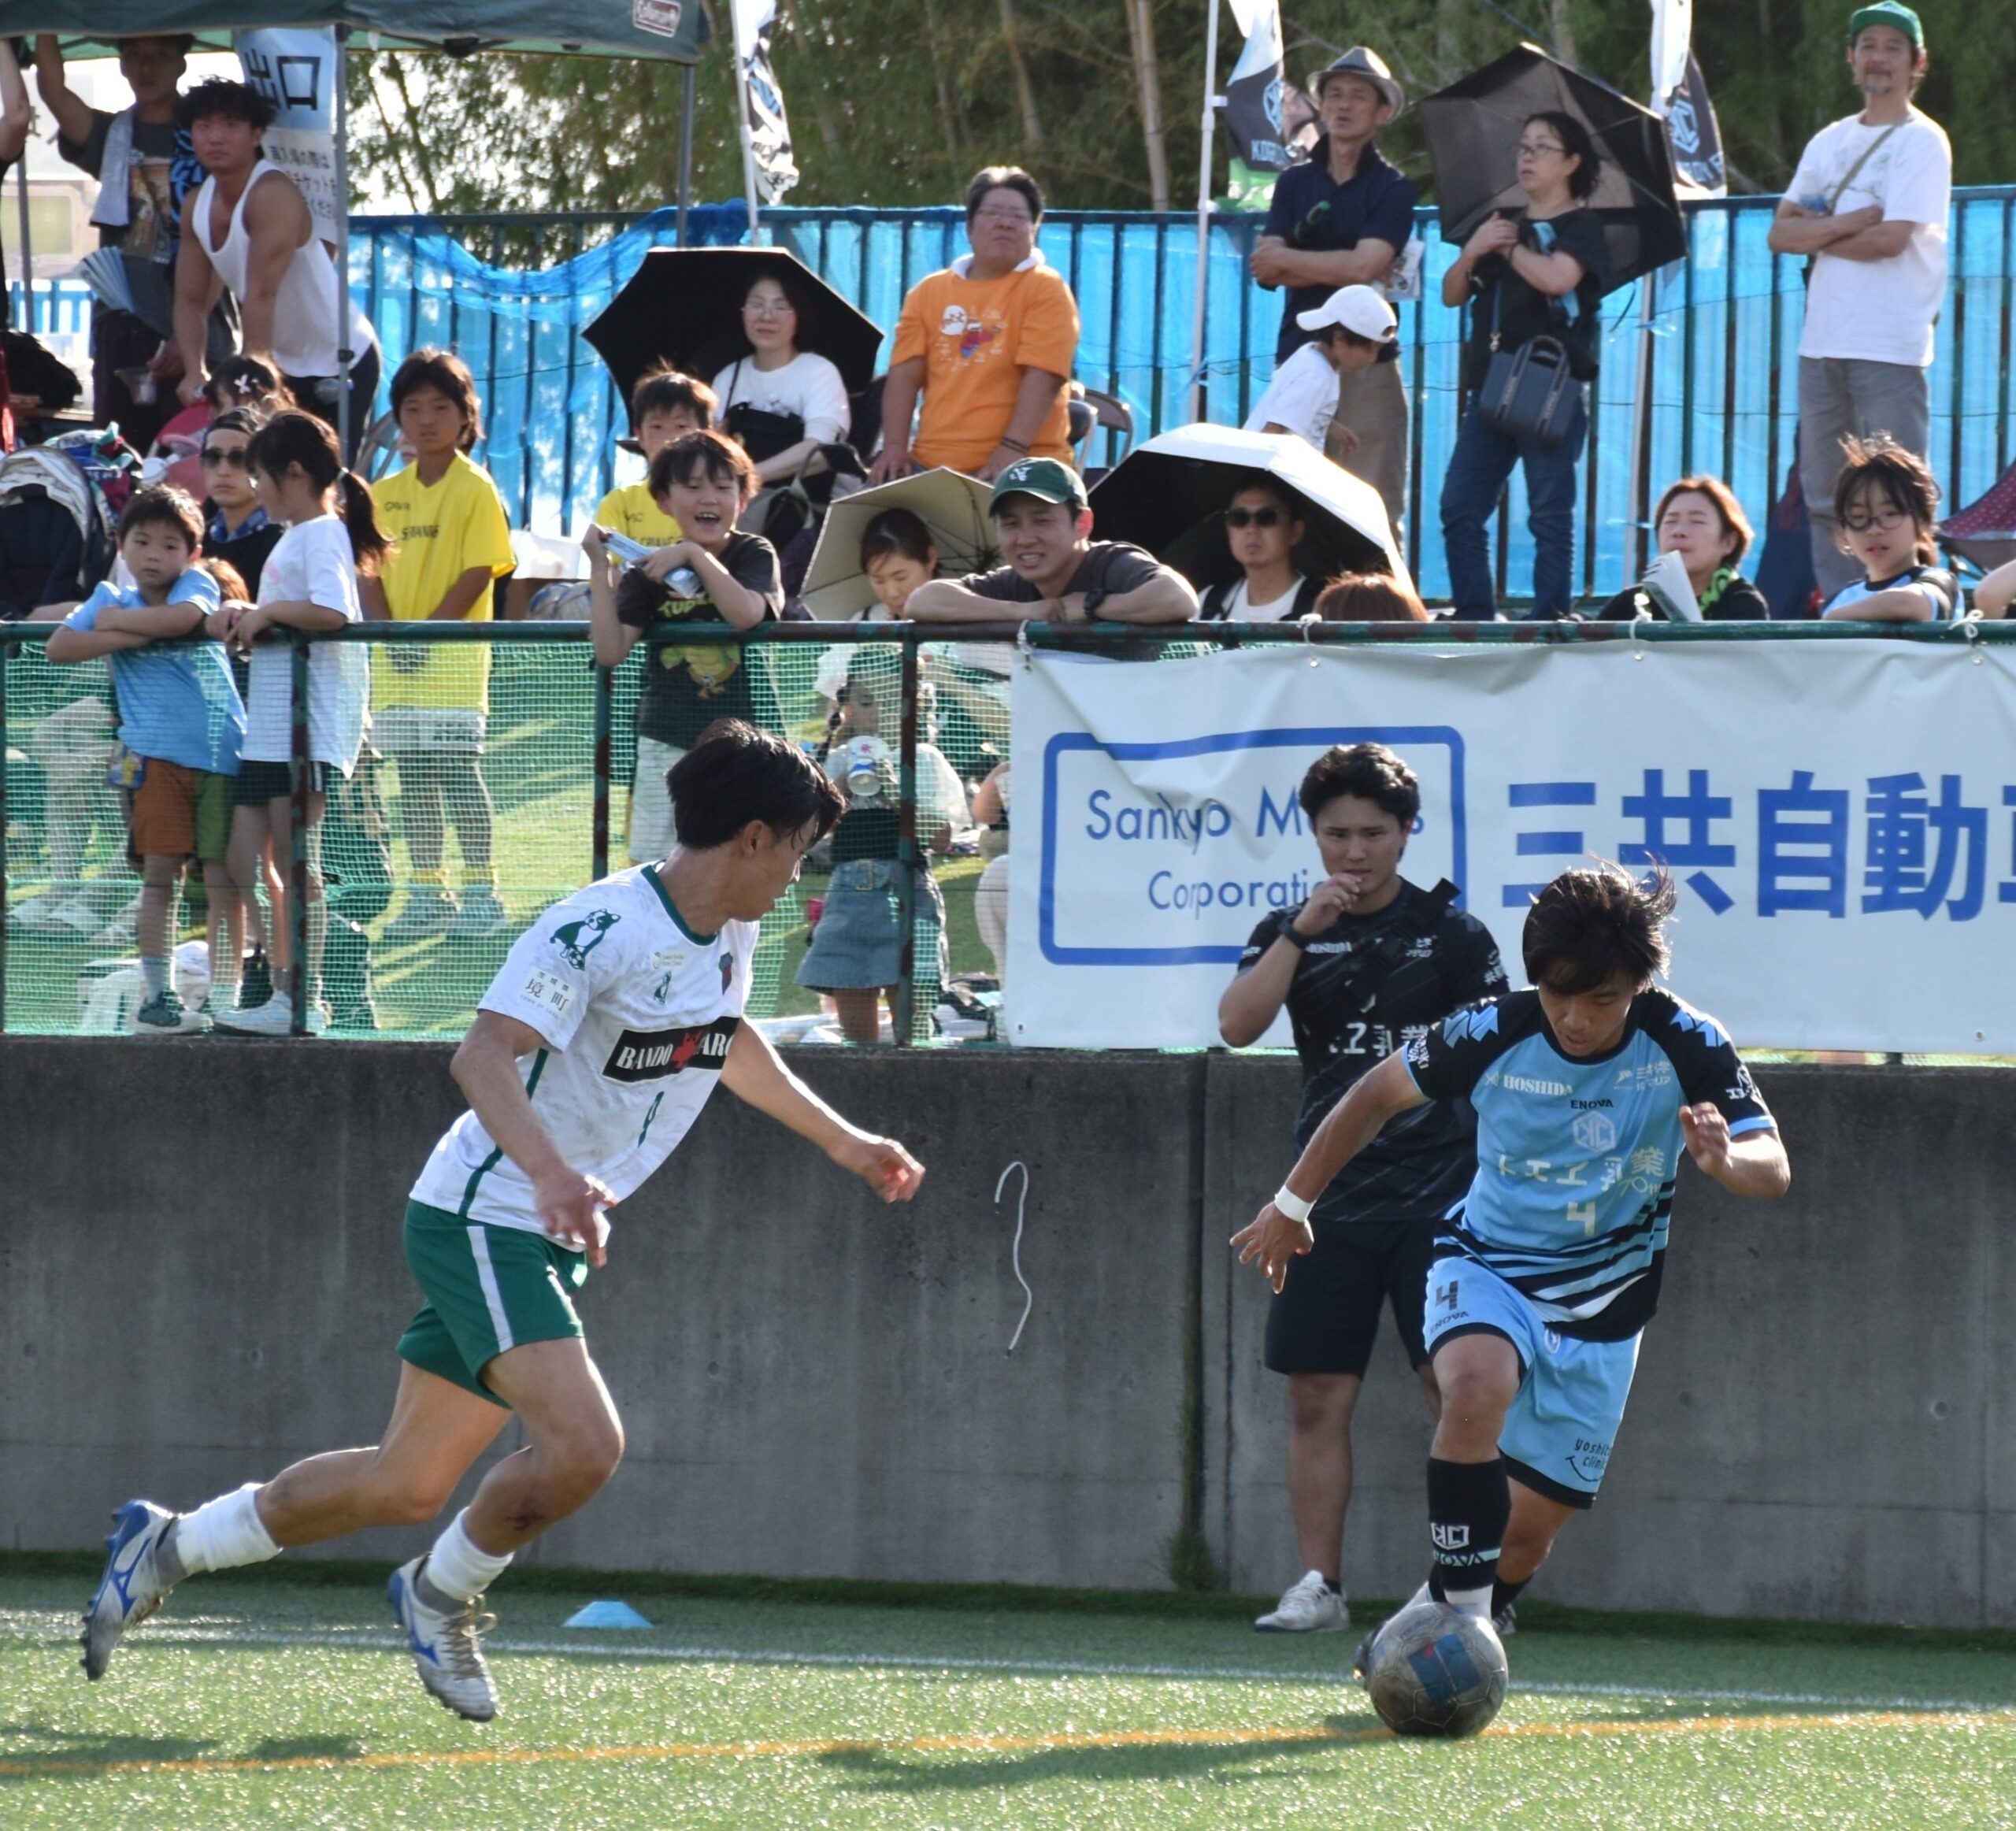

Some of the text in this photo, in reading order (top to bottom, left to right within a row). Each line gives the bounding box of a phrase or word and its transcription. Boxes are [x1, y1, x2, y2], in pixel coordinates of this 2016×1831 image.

[1086, 790, 1231, 855] Sankyo
[1503, 769, 2016, 921] 三共自動
[524, 978, 569, 1011] 境町
[615, 1043, 674, 1070] BANDO
[1503, 1073, 1573, 1096] HOSHIDA
[1570, 1099, 1614, 1110] ENOVA
[1566, 1201, 1596, 1236] 4
[1436, 1279, 1458, 1310] 4
[1429, 1310, 1469, 1335] ENOVA
